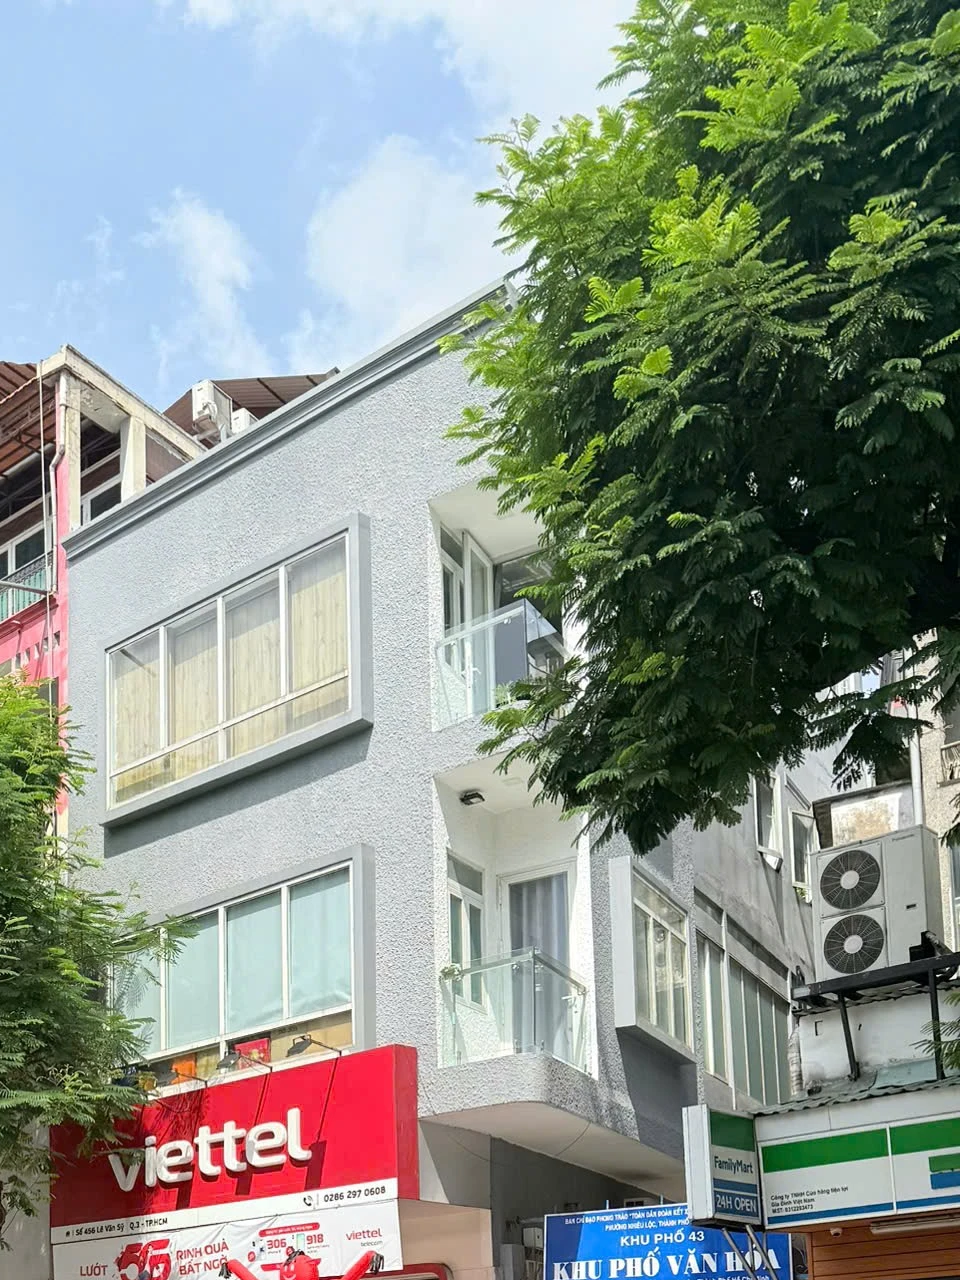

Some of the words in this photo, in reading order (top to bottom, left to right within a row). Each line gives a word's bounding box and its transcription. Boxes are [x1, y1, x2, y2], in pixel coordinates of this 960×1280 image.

[108, 1107, 313, 1192] viettel
[714, 1155, 753, 1175] FamilyMart
[323, 1191, 344, 1203] 0286
[346, 1190, 362, 1199] 297
[364, 1185, 386, 1197] 0608
[715, 1193, 733, 1210] 24H
[734, 1197, 757, 1214] OPEN
[129, 1221, 140, 1230] Q.3
[145, 1217, 168, 1228] TP.HCM
[266, 1238, 287, 1249] 306
[306, 1233, 324, 1245] 918
[345, 1228, 383, 1241] viettel
[620, 1235, 650, 1247] KHU
[654, 1227, 685, 1245] PHỐ
[688, 1230, 705, 1242] 43
[176, 1246, 202, 1261] RINH
[80, 1262, 108, 1277] LƯỚT
[552, 1260, 603, 1280] KHU
[608, 1246, 661, 1279] PHỐ
[666, 1248, 718, 1275] VĂN
